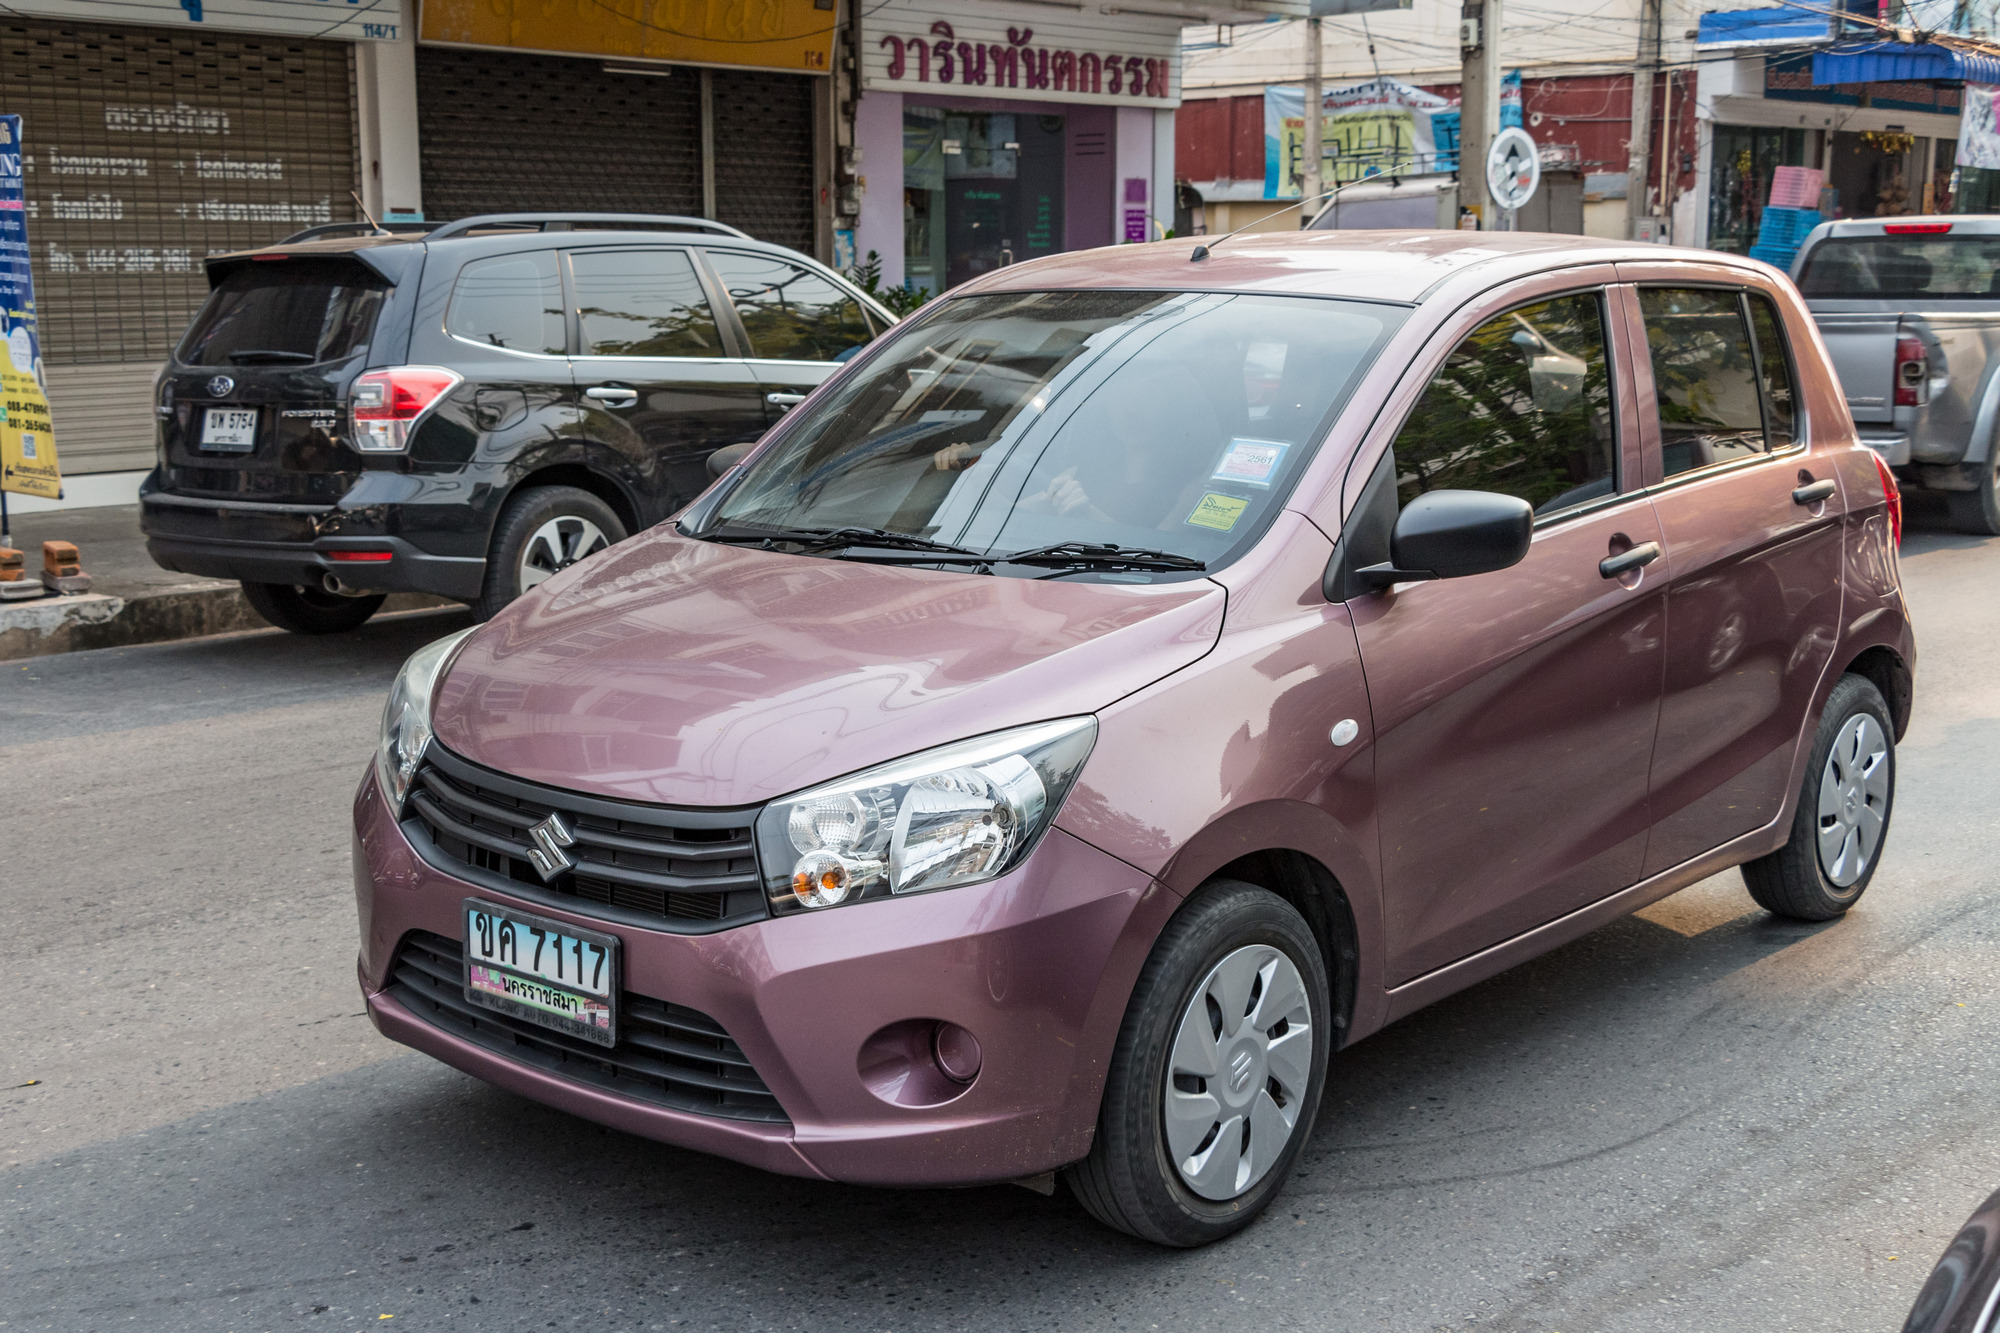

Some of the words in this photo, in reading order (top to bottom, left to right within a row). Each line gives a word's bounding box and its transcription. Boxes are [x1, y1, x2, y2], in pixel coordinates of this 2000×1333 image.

[362, 23, 396, 40] 114/1
[880, 20, 1169, 98] วารินทันตกรรม
[229, 412, 255, 430] 5754
[1247, 454, 1273, 465] 2561
[476, 912, 517, 966] ขค
[529, 926, 606, 990] 7117
[502, 976, 578, 1014] นครราชสีมา
